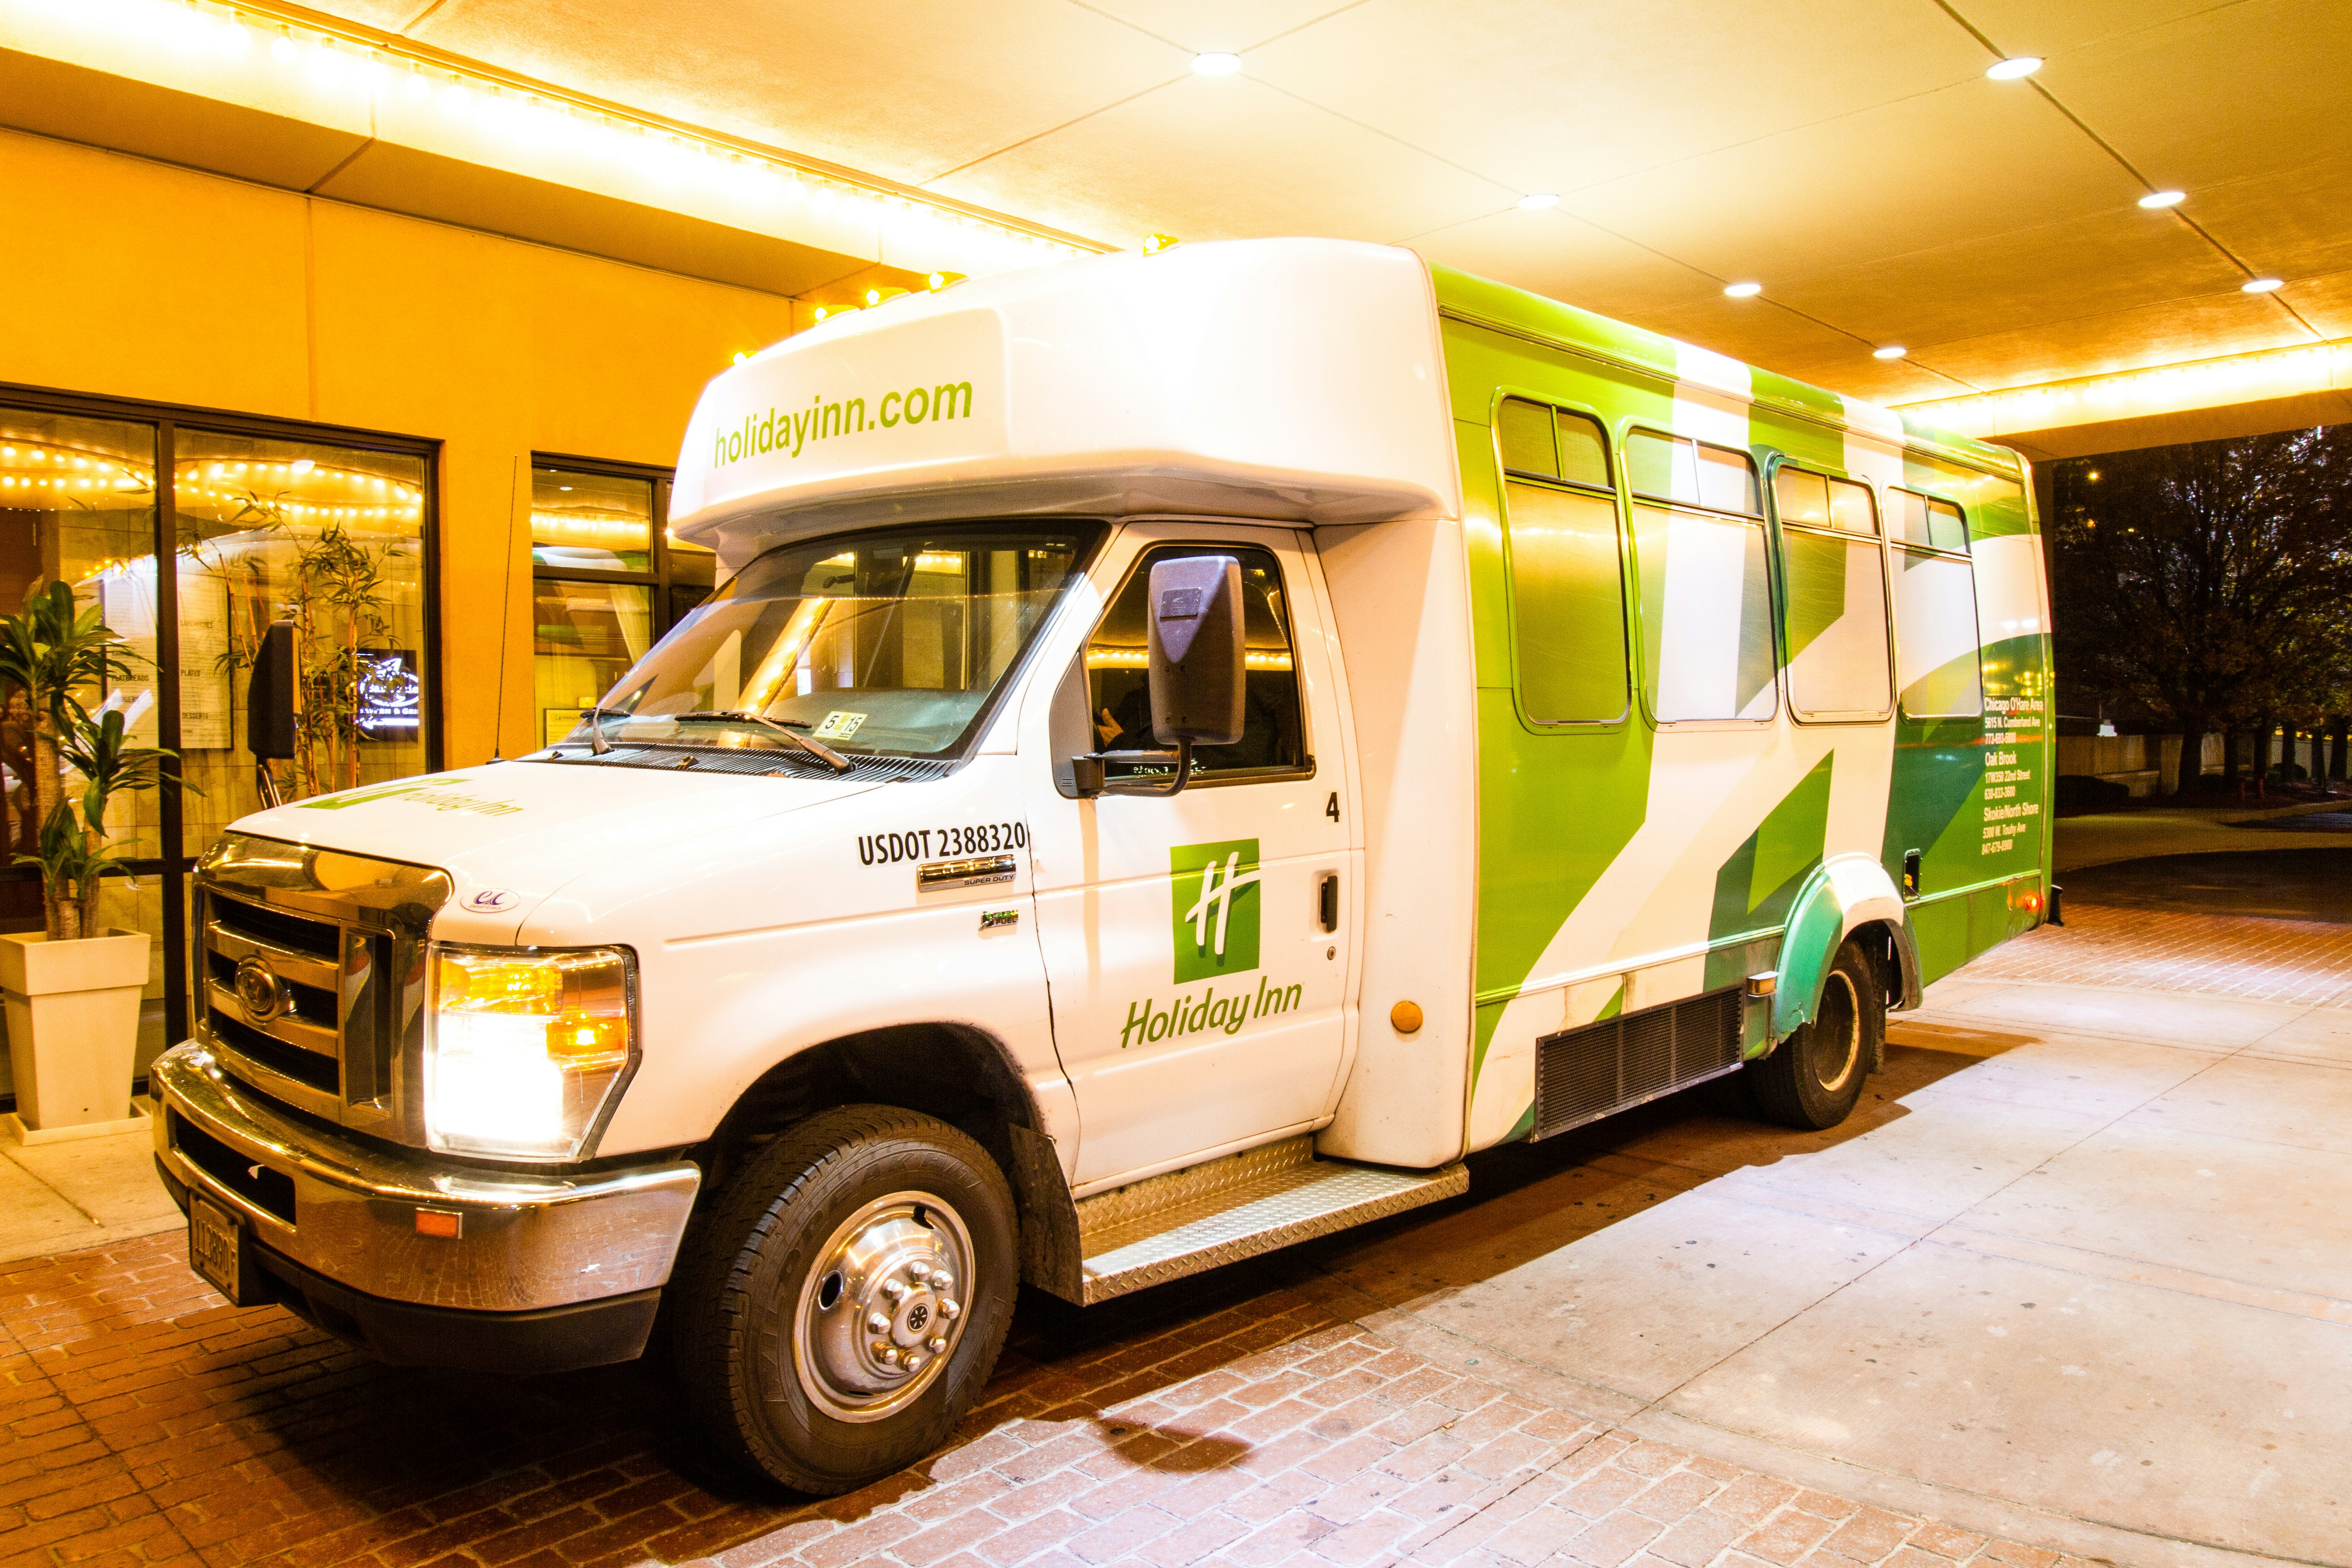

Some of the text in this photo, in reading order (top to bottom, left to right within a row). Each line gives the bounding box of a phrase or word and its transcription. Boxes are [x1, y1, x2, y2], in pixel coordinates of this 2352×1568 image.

[714, 381, 973, 469] holidayinn.com
[1984, 696, 2043, 714] Chicago O'Hare Area
[825, 715, 862, 732] 5 15
[1985, 751, 2017, 766] Oak Brook
[2017, 769, 2031, 780] Street
[1326, 792, 1340, 823] 4
[2022, 802, 2038, 816] Shore
[858, 822, 1026, 866] USDOT 2388320
[1121, 976, 1303, 1049] Holiday Inn
